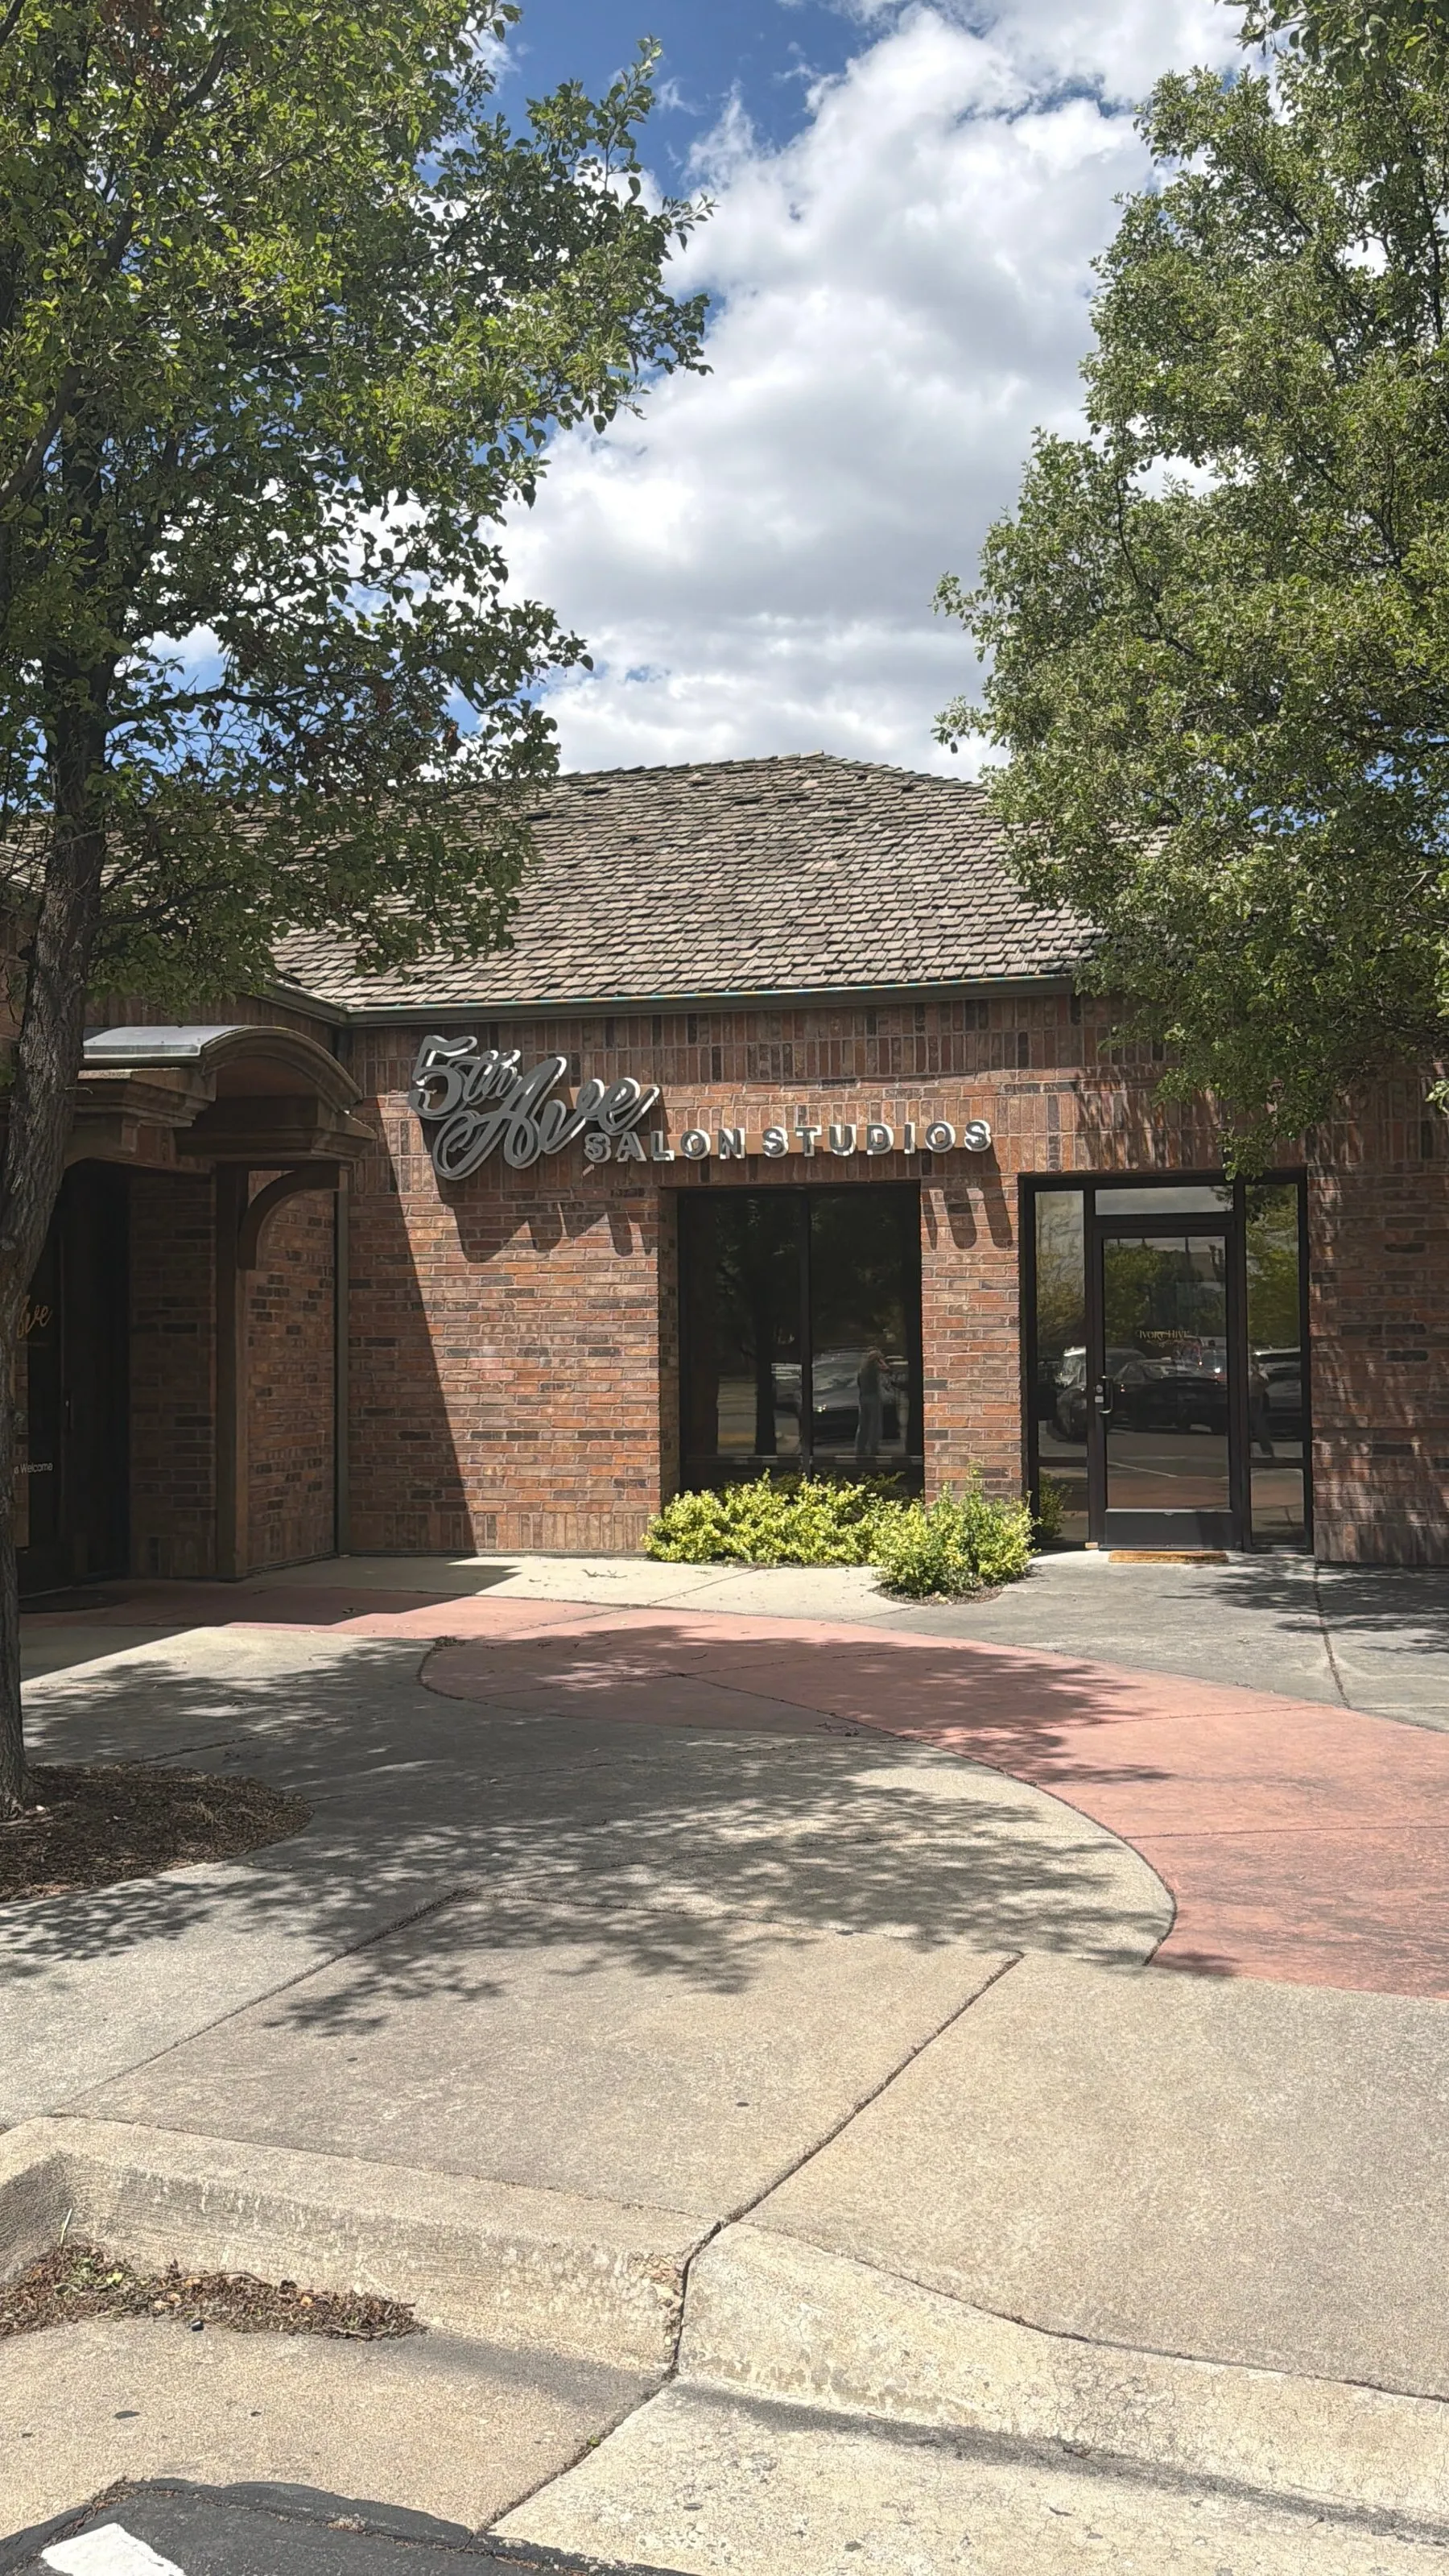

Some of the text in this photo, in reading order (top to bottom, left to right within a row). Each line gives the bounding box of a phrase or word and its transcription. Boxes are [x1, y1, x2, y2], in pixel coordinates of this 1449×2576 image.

[408, 1036, 660, 1180] 5th Ave
[583, 1119, 991, 1163] SALON STUDIOS
